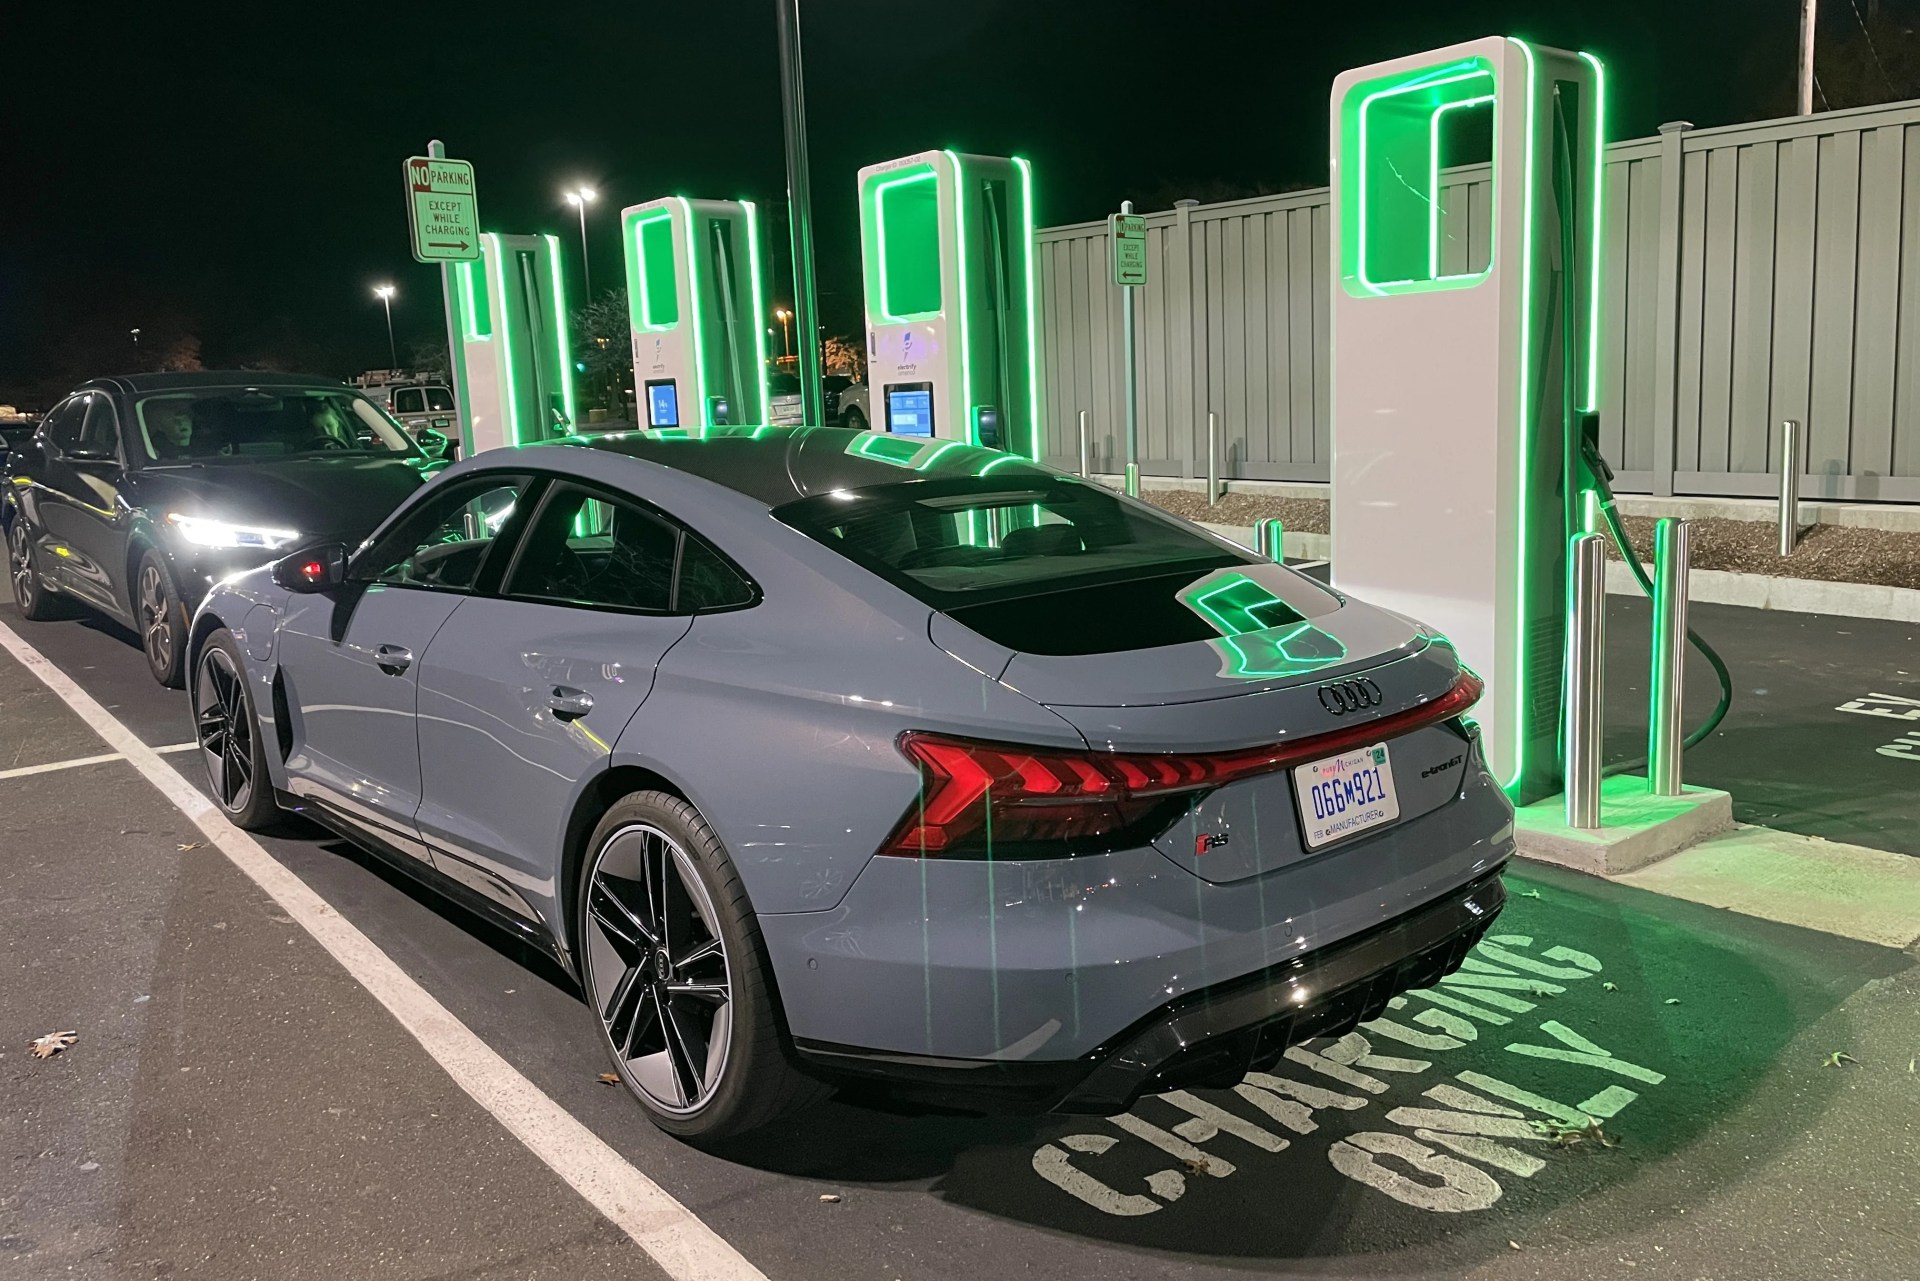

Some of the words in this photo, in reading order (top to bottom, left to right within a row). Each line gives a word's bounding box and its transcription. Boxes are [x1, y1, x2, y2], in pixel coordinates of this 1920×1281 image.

[411, 166, 430, 186] NO
[431, 170, 470, 186] PARKING
[429, 201, 461, 212] EXCEPT
[433, 214, 460, 224] WHILE
[425, 225, 470, 236] CHARGING
[1314, 829, 1324, 839] FEB
[1329, 809, 1380, 834] MANUFACTURER
[1194, 832, 1230, 857] RS
[1032, 935, 1603, 1216] CHARGING
[1328, 1020, 1666, 1213] ONLY
